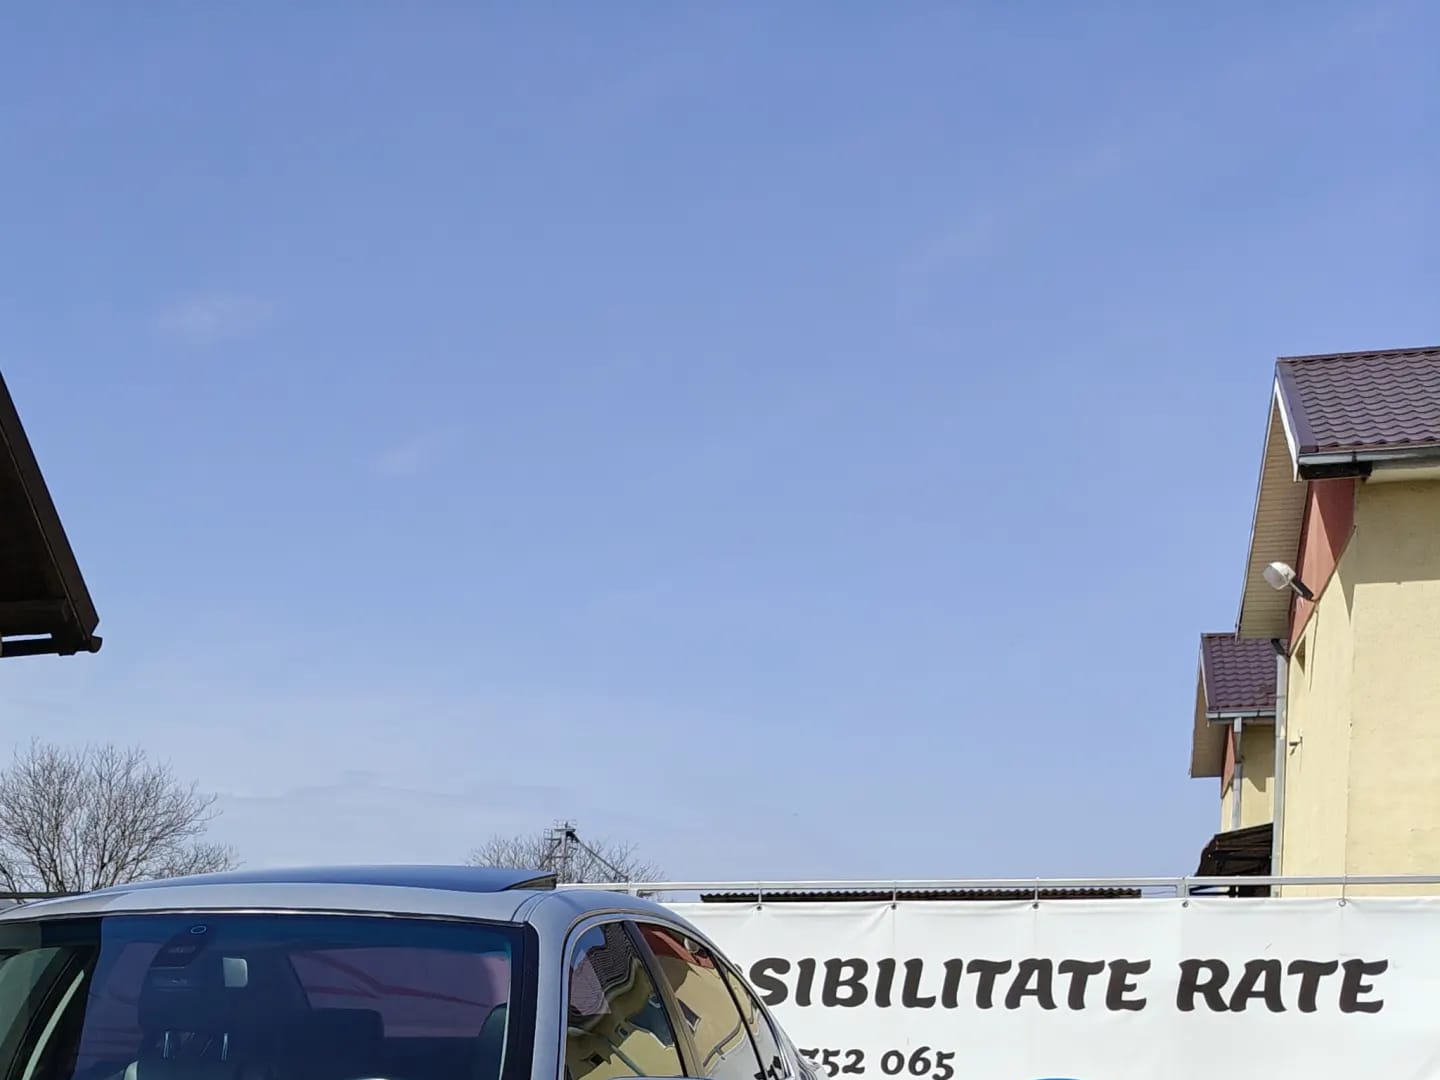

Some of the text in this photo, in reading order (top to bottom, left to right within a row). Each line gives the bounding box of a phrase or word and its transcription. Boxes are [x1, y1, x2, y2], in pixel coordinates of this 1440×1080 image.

[736, 957, 1388, 1013] SIBILITATE RATE
[880, 1047, 955, 1080] 065
